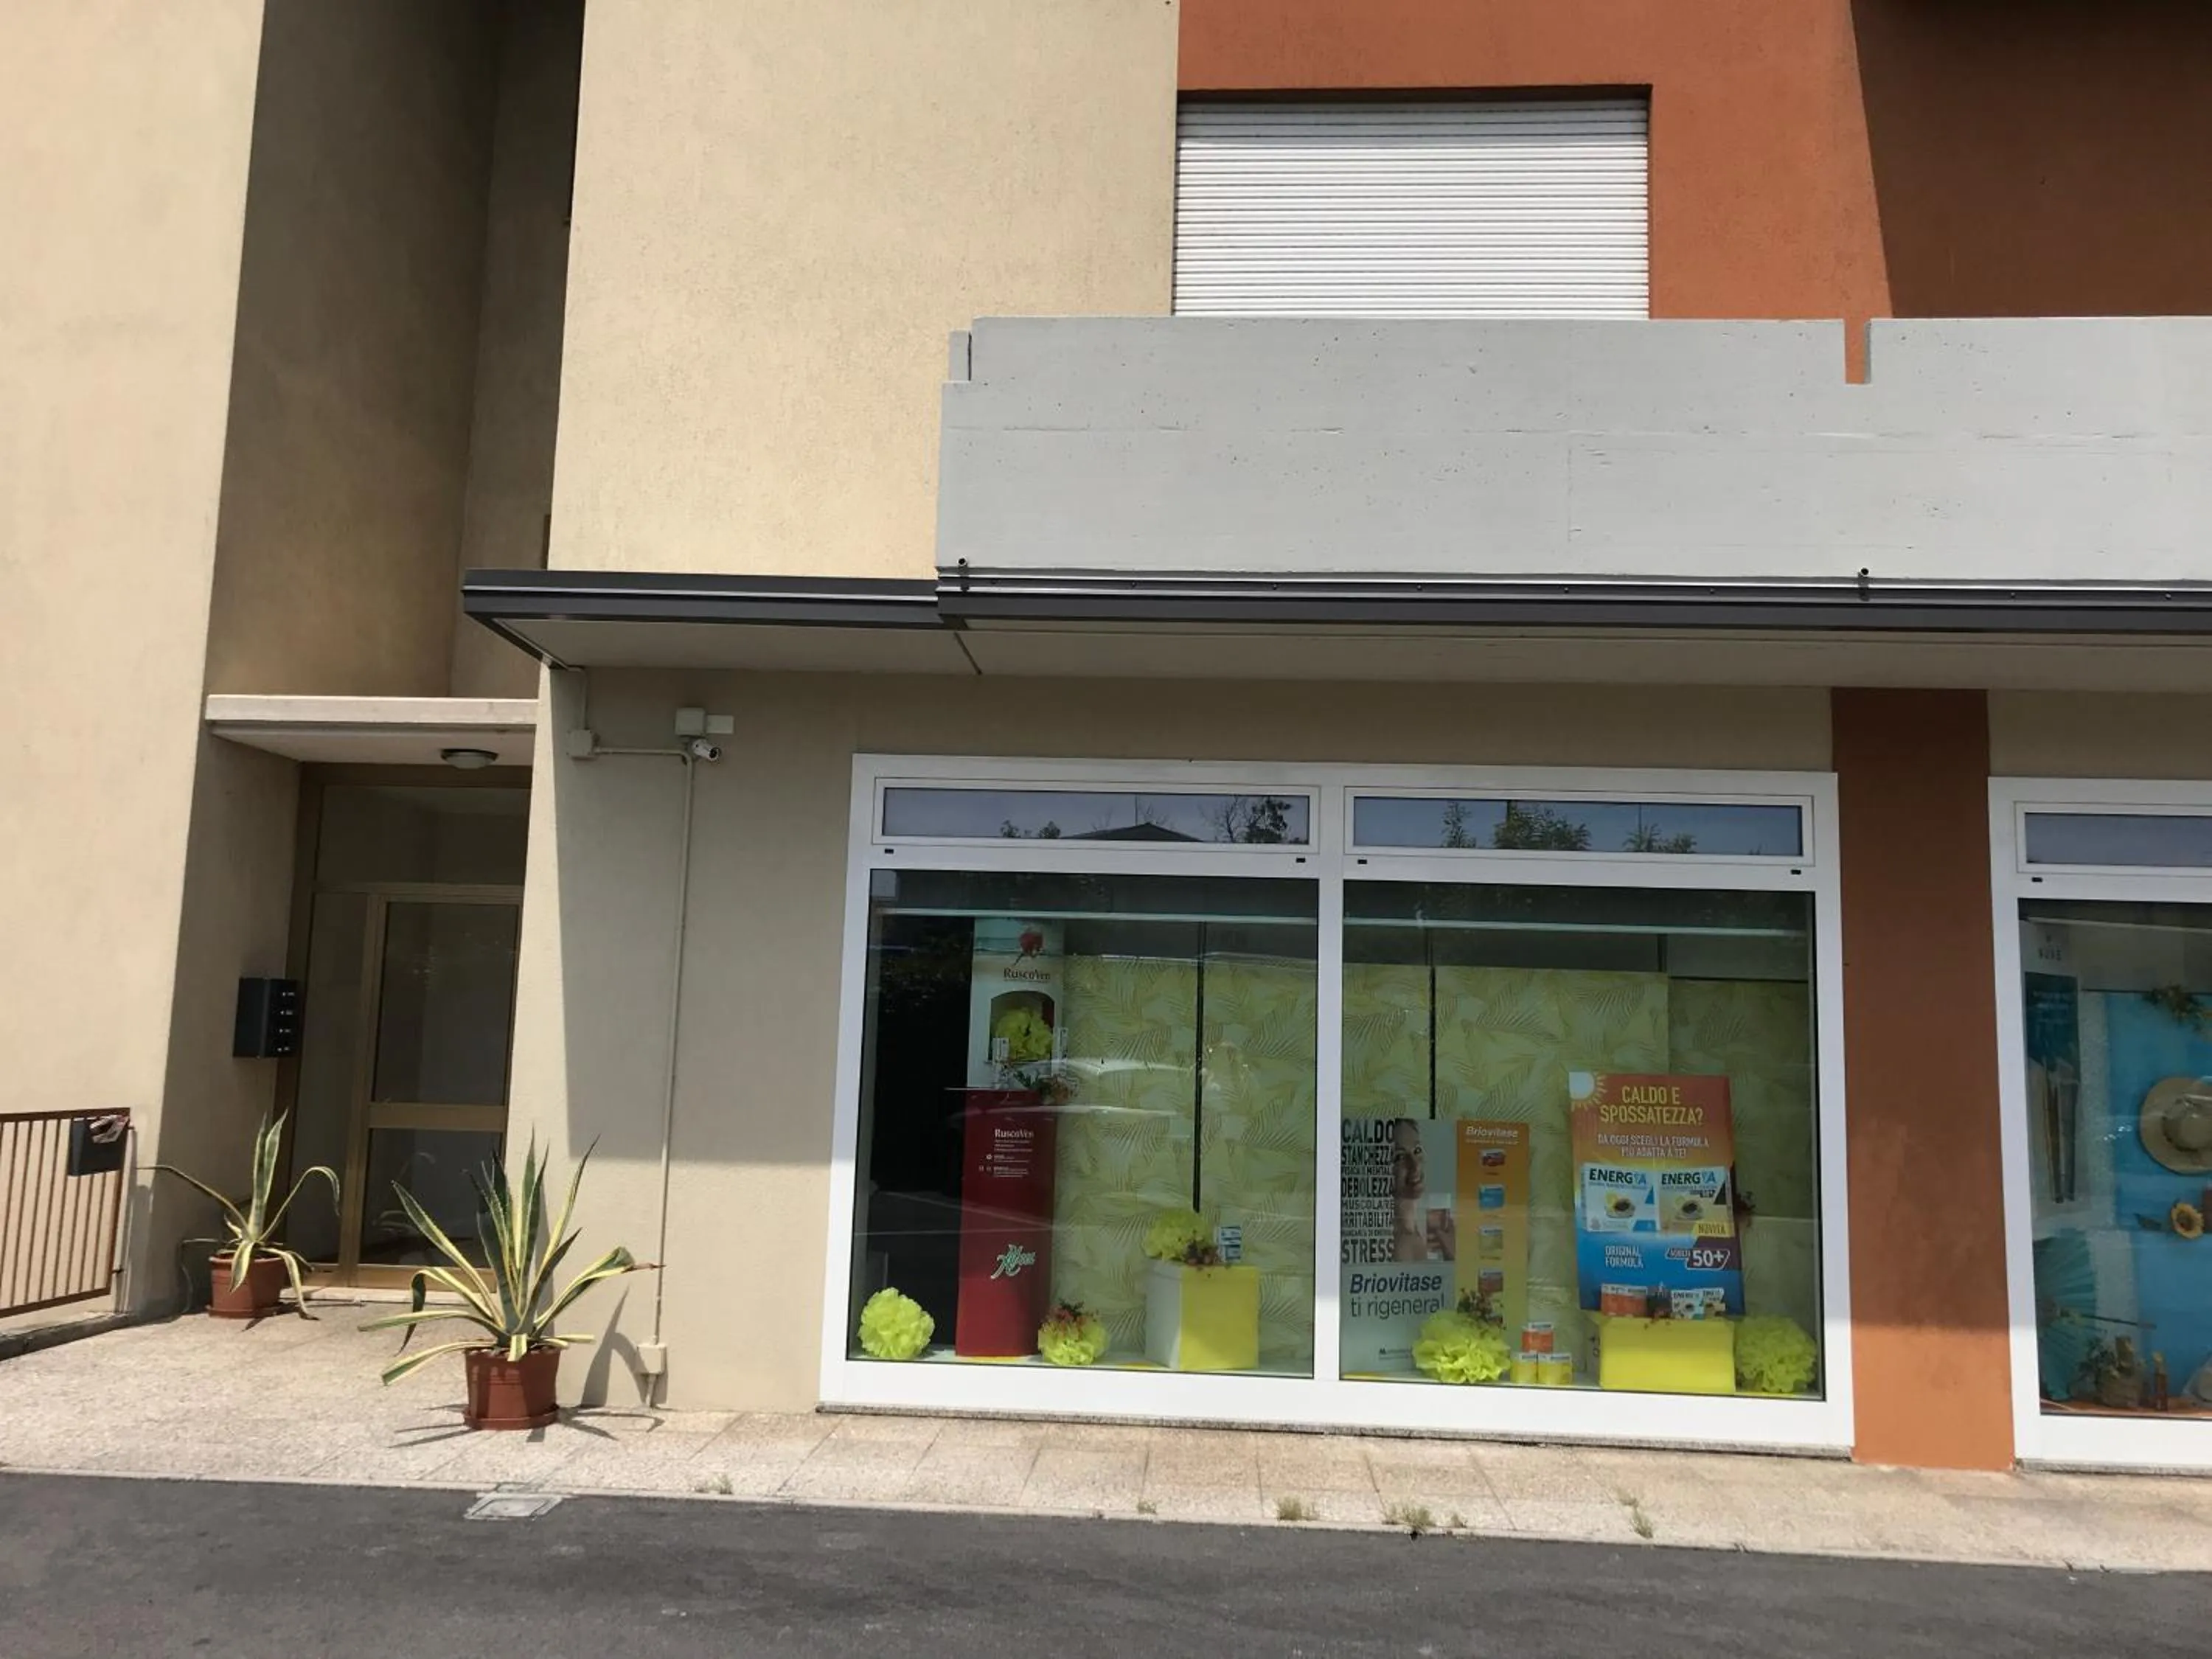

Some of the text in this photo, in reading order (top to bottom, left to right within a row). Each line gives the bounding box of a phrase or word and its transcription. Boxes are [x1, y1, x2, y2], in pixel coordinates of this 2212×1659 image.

[1622, 1085, 1680, 1105] CALDO E
[1599, 1105, 1704, 1126] SPOSSATEZZA?
[1342, 1119, 1394, 1143] CALDO
[1466, 1126, 1518, 1138] Briovitase
[1342, 1239, 1394, 1263] STRESS
[1605, 1245, 1641, 1256] ORIGINAL
[1692, 1249, 1725, 1267] 50+
[1605, 1256, 1644, 1269] FORMULA
[1350, 1272, 1442, 1293] Briovitase
[1351, 1296, 1361, 1317] ti
